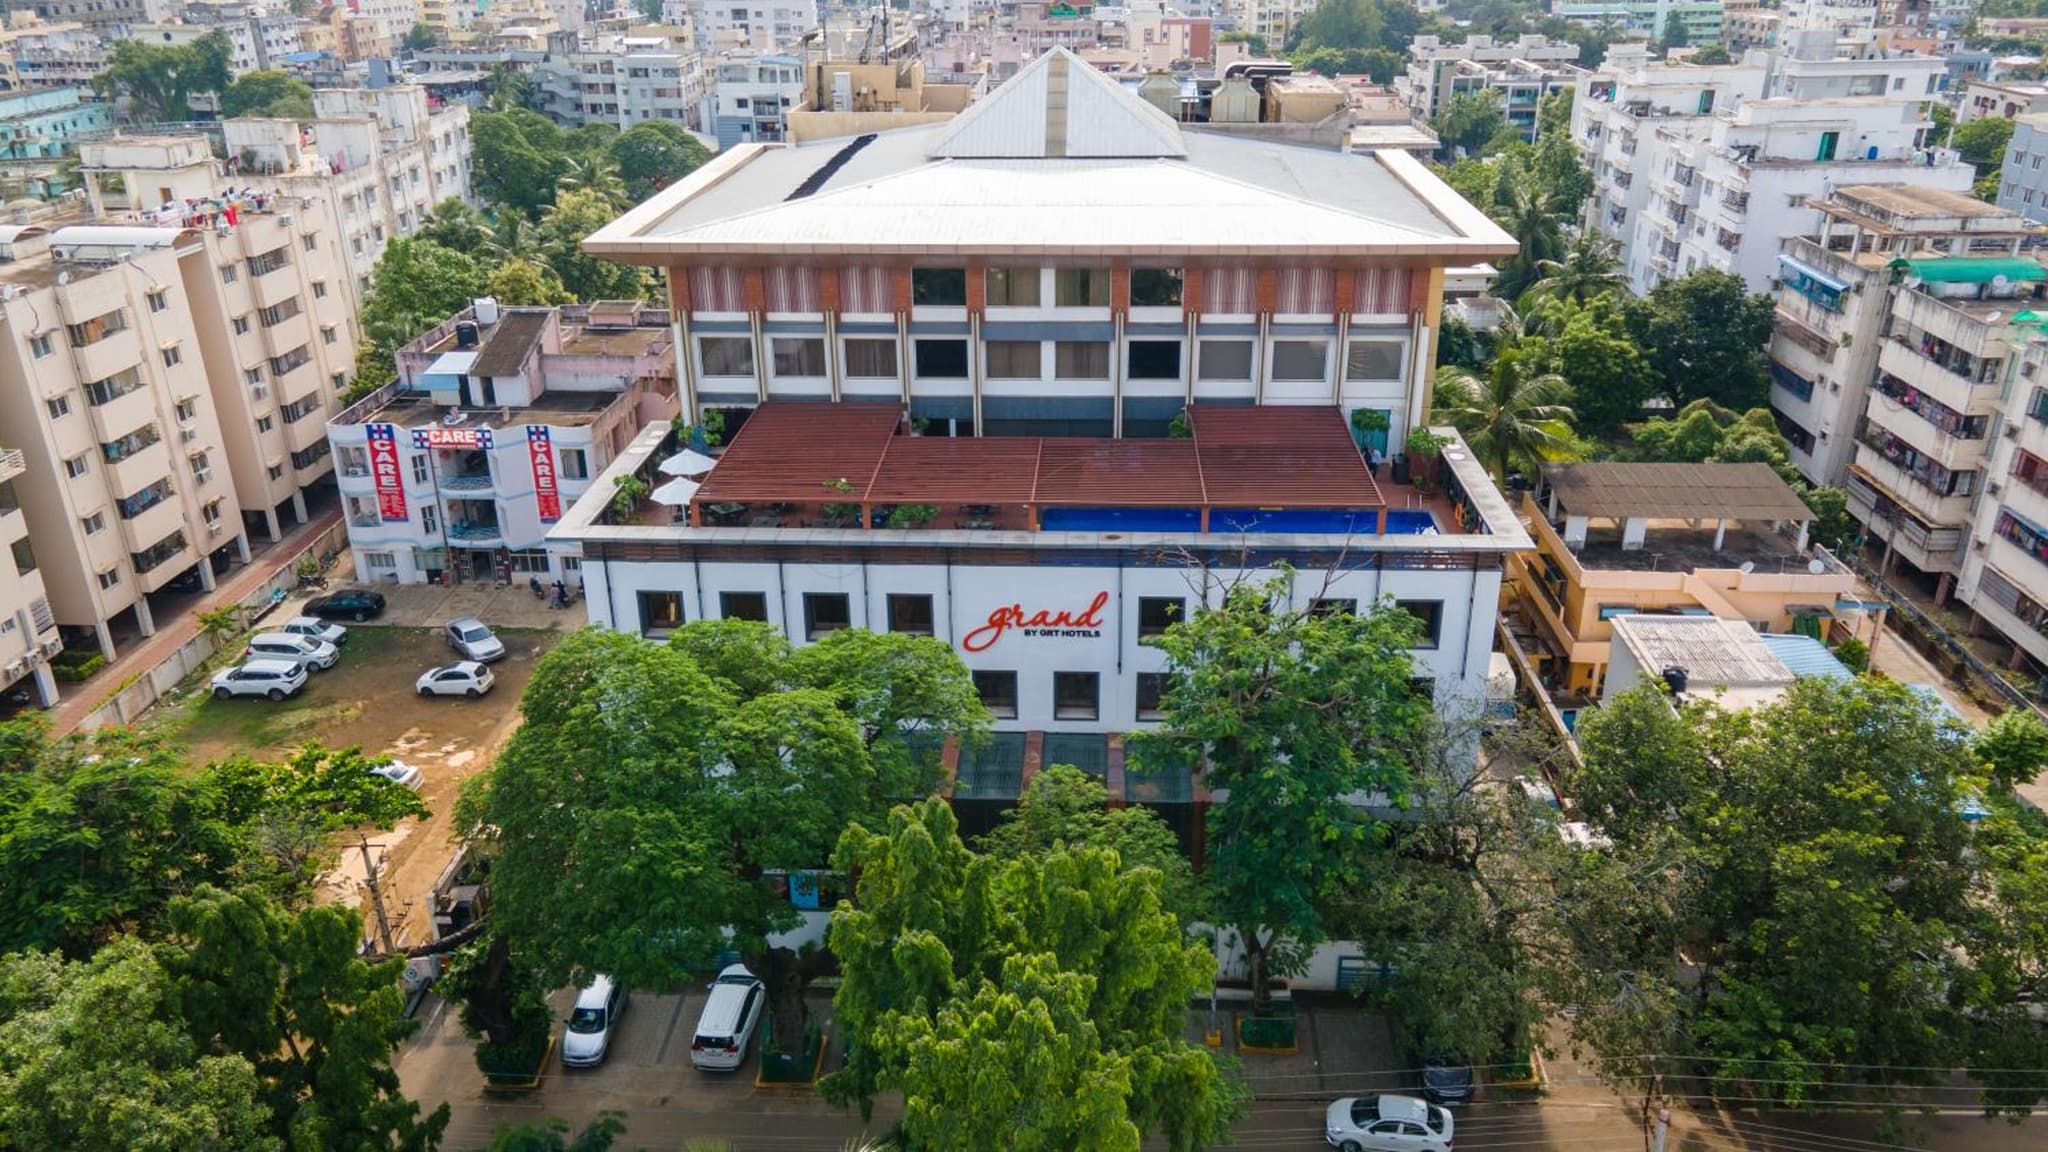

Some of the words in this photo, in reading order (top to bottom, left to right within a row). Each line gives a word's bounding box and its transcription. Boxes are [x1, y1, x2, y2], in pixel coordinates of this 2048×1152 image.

[429, 430, 475, 443] CARE
[373, 440, 398, 486] CARE
[532, 441, 553, 487] CARE
[963, 591, 1108, 652] grand
[1024, 629, 1037, 637] BY
[1061, 629, 1101, 638] HOTELS
